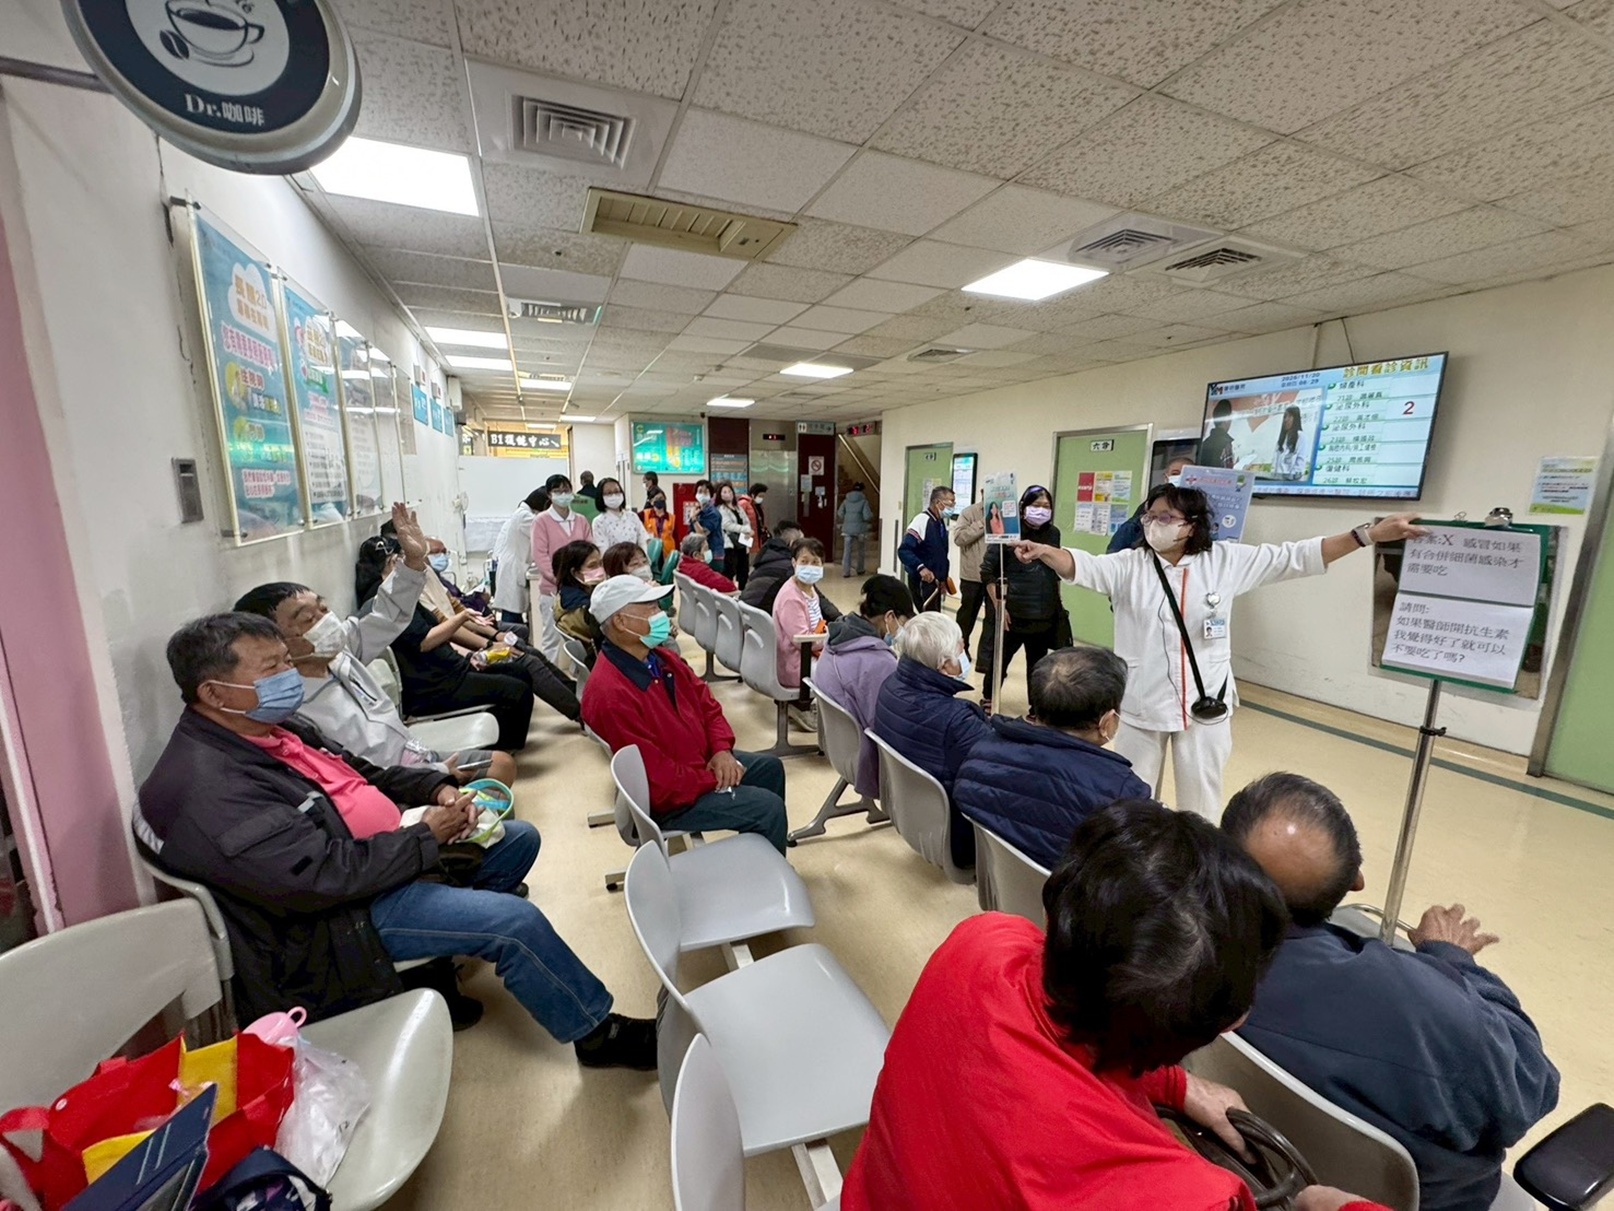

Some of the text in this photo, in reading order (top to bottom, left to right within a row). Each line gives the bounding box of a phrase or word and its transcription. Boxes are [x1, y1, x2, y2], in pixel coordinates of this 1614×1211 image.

[1344, 358, 1428, 378] 診間看診資訊
[1402, 401, 1415, 415] 2
[1463, 538, 1521, 553] 感冒如果
[1407, 563, 1448, 576] 需要吃
[1397, 617, 1510, 640] 如果醫師開抗生素
[1394, 629, 1506, 655] 我覺得好了就可以
